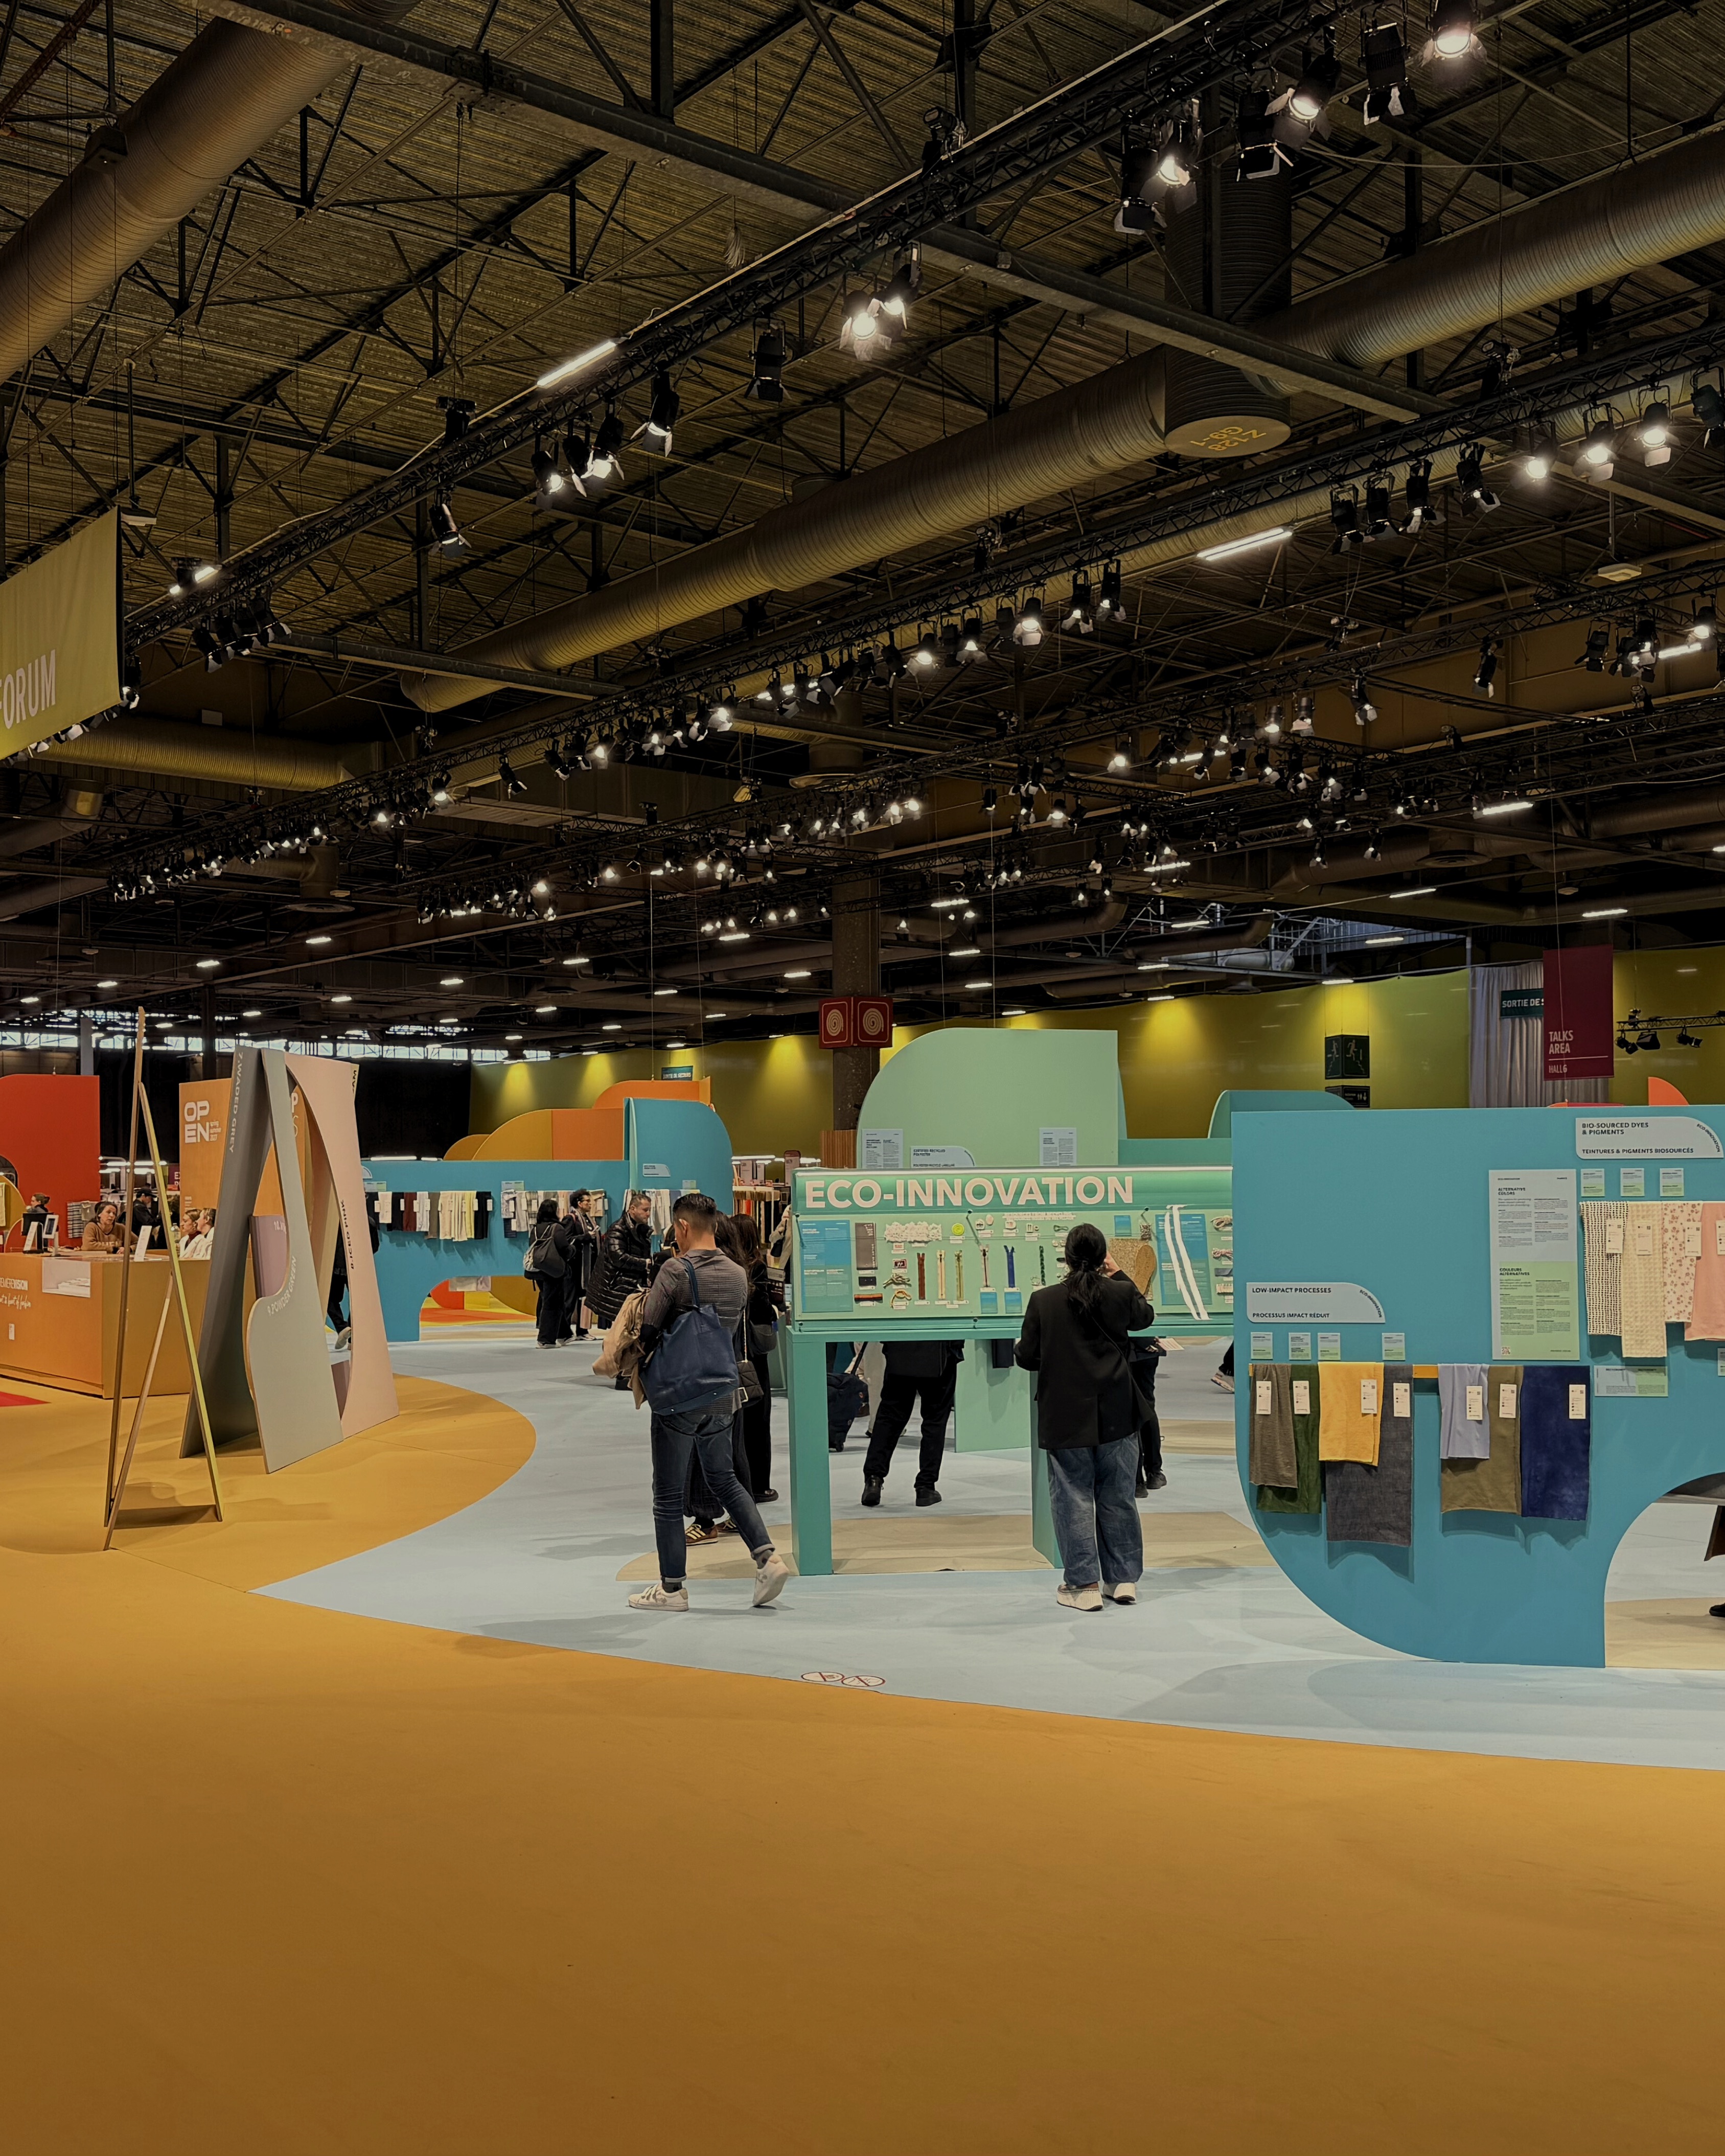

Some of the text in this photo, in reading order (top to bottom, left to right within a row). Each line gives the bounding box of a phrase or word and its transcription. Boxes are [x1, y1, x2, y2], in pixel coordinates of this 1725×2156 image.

[1208, 429, 1267, 451] Z128
[0, 649, 56, 730] ORUM
[1502, 999, 1529, 1008] SORTIE
[1530, 998, 1540, 1006] DE
[1549, 1030, 1574, 1042] TALKS
[1549, 1042, 1571, 1054] AREA
[229, 1118, 237, 1153] GREY
[805, 1176, 1134, 1208] ECO-INNOVATION
[289, 1255, 297, 1293] GREEN
